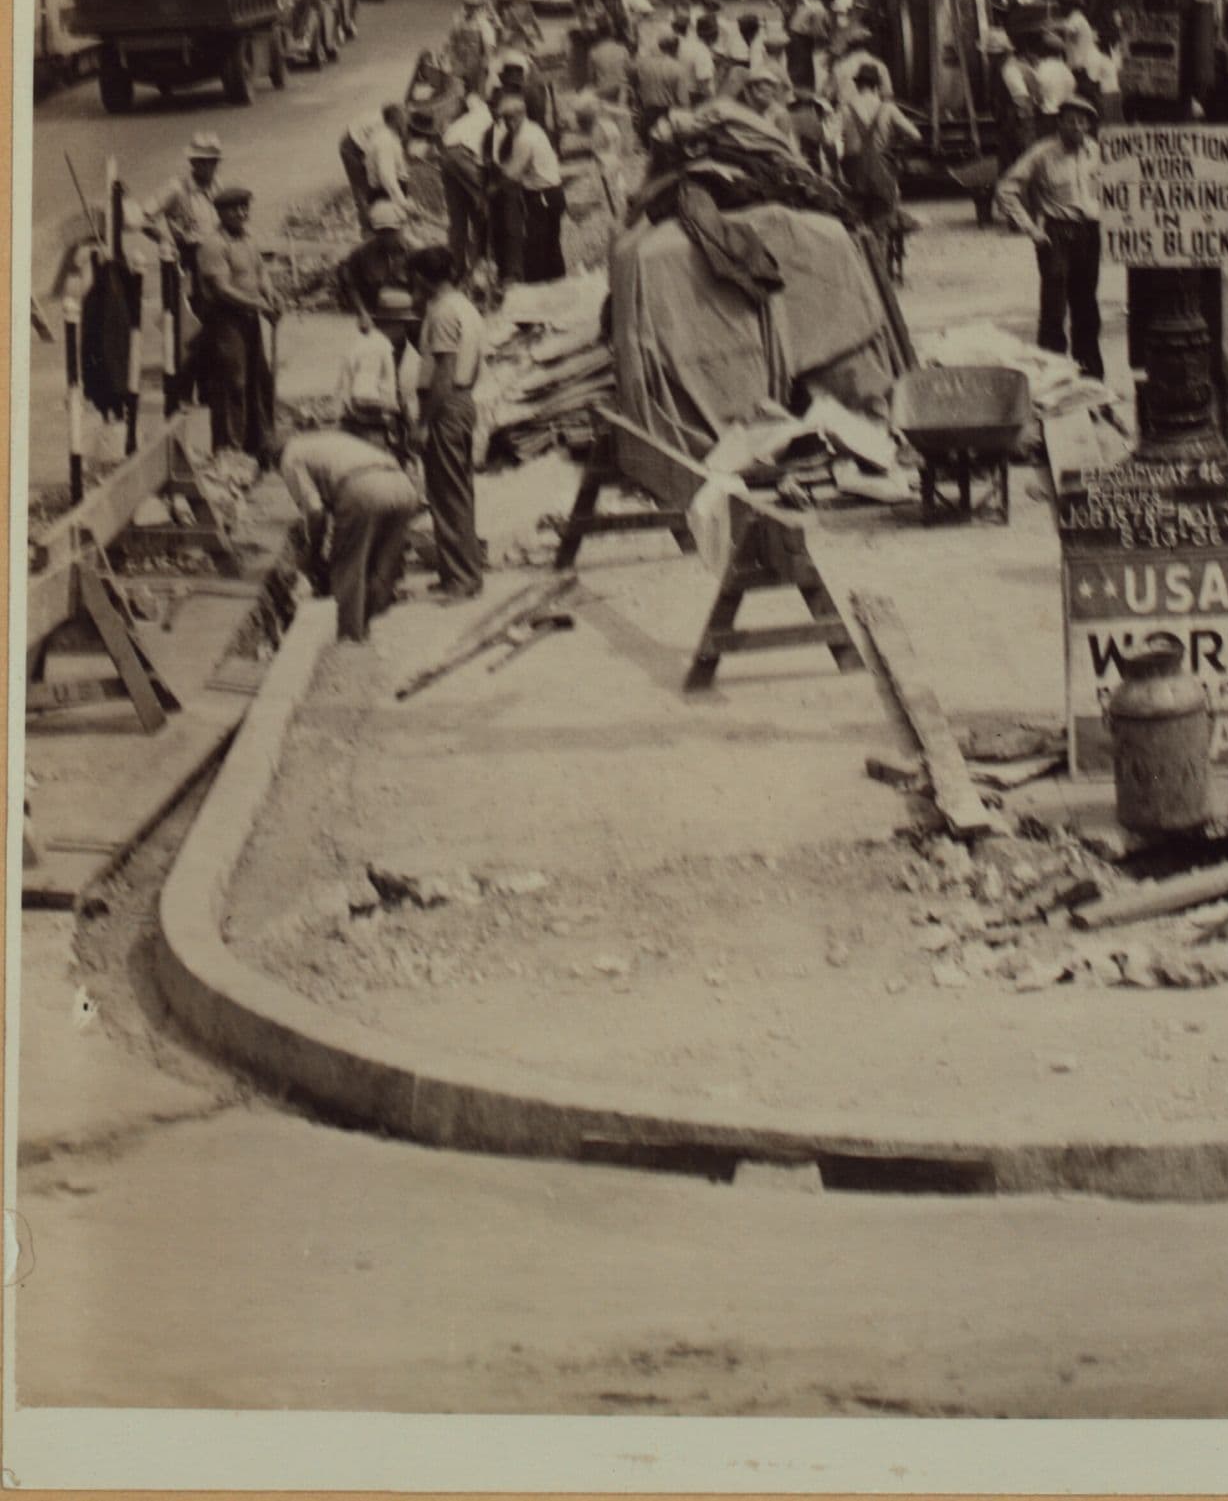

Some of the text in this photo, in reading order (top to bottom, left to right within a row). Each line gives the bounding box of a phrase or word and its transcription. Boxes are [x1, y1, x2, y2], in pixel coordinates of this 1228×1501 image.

[1138, 157, 1195, 181] WORK
[1102, 182, 1129, 211] NO
[1153, 211, 1180, 229] IN
[1106, 229, 1152, 256] THIS
